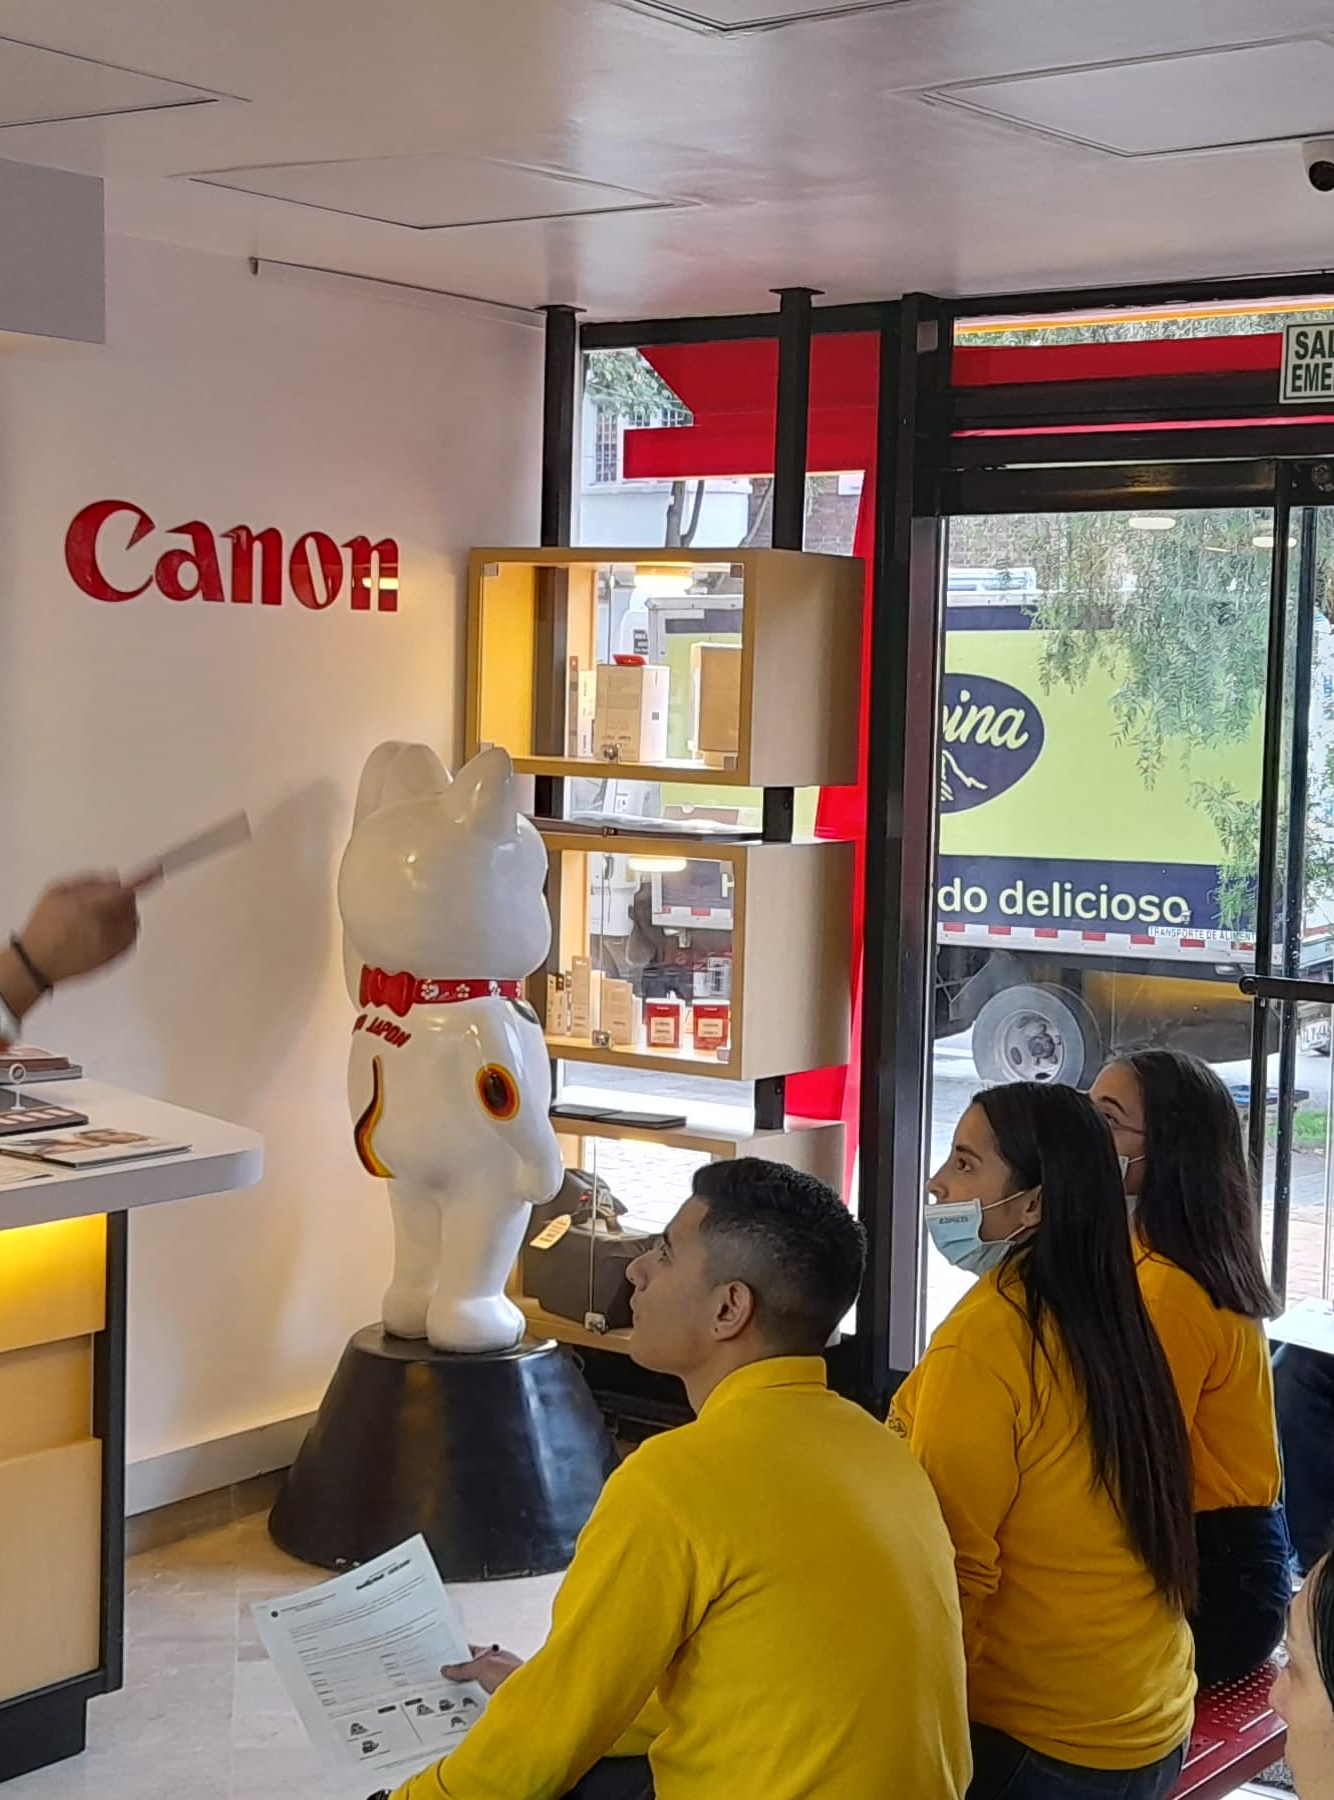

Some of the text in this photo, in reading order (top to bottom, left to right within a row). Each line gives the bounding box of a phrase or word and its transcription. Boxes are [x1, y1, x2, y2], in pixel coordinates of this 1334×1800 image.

[65, 498, 400, 613] Canon
[942, 689, 1029, 750] ina
[938, 877, 1189, 924] do delicioso
[1149, 926, 1204, 940] TRANSPORTE
[1206, 930, 1218, 941] DE
